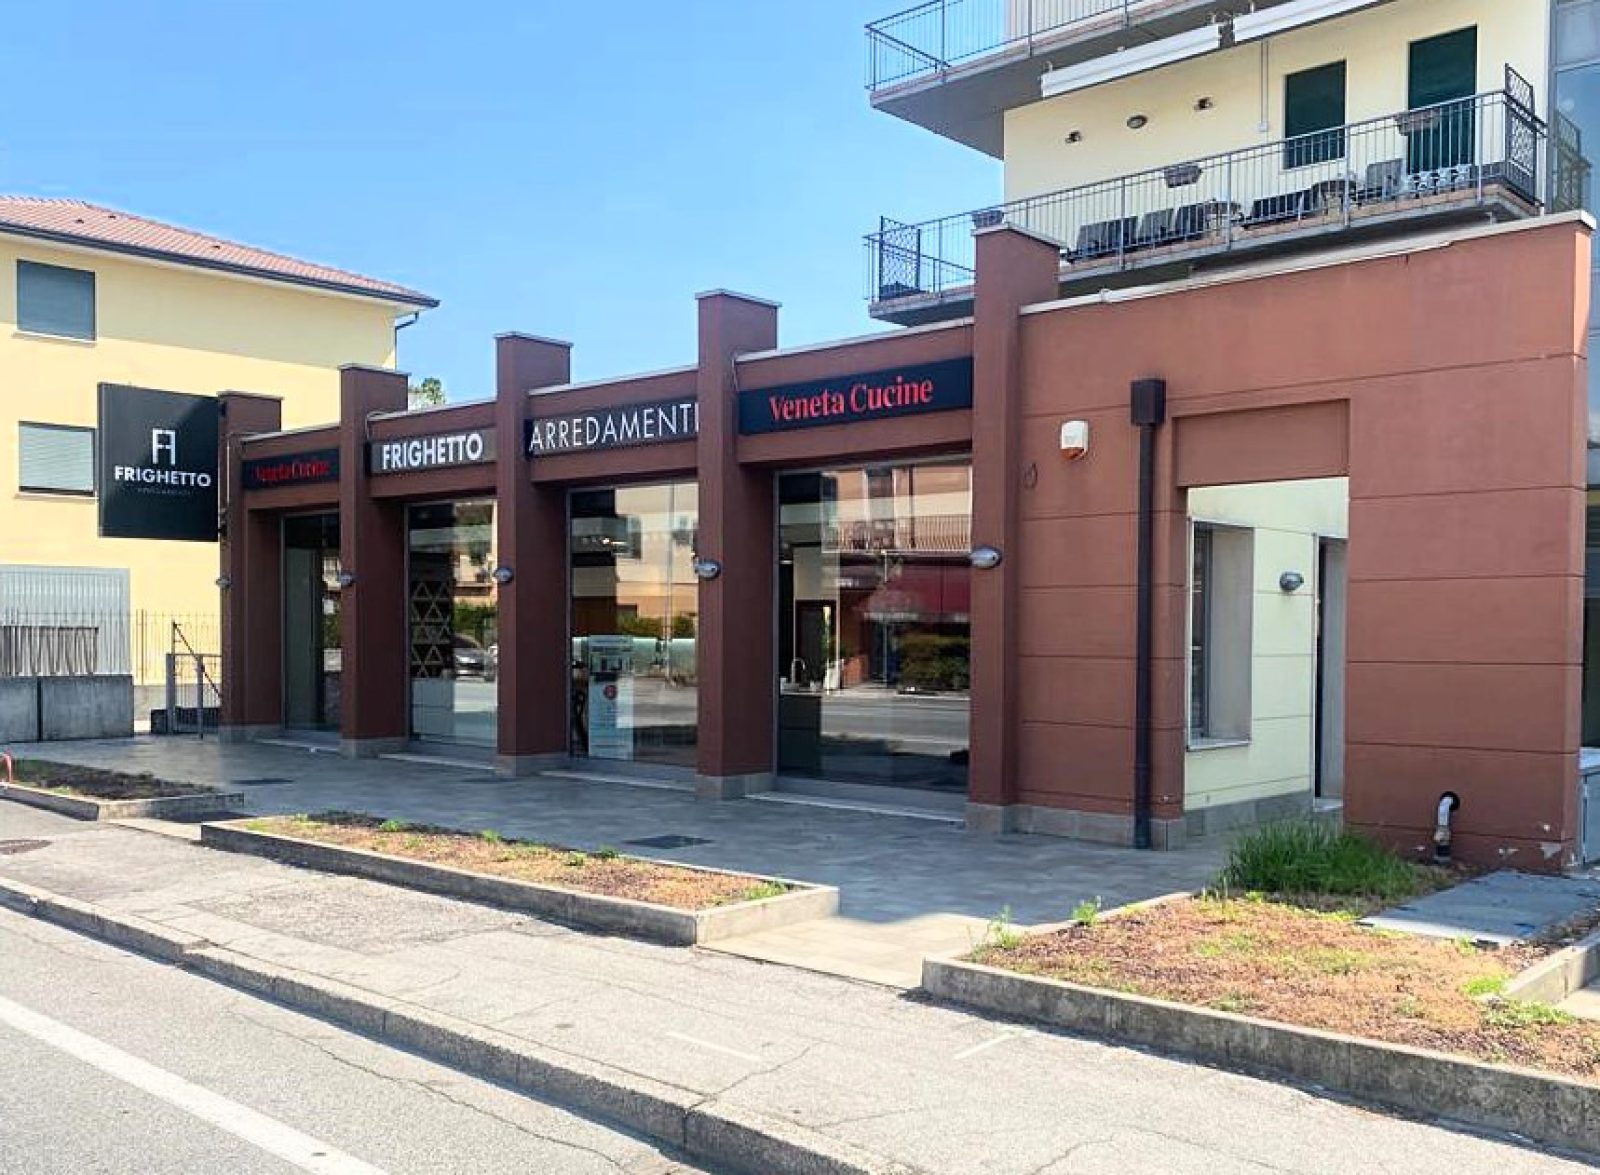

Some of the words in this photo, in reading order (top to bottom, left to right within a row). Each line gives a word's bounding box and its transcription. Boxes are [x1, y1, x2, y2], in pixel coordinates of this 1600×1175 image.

[768, 388, 845, 422] Veneta
[850, 376, 934, 413] Cucine
[528, 402, 699, 452] ARREDAMENTI
[382, 433, 483, 470] FRIGHETTO
[114, 464, 211, 487] FRIGHETTO
